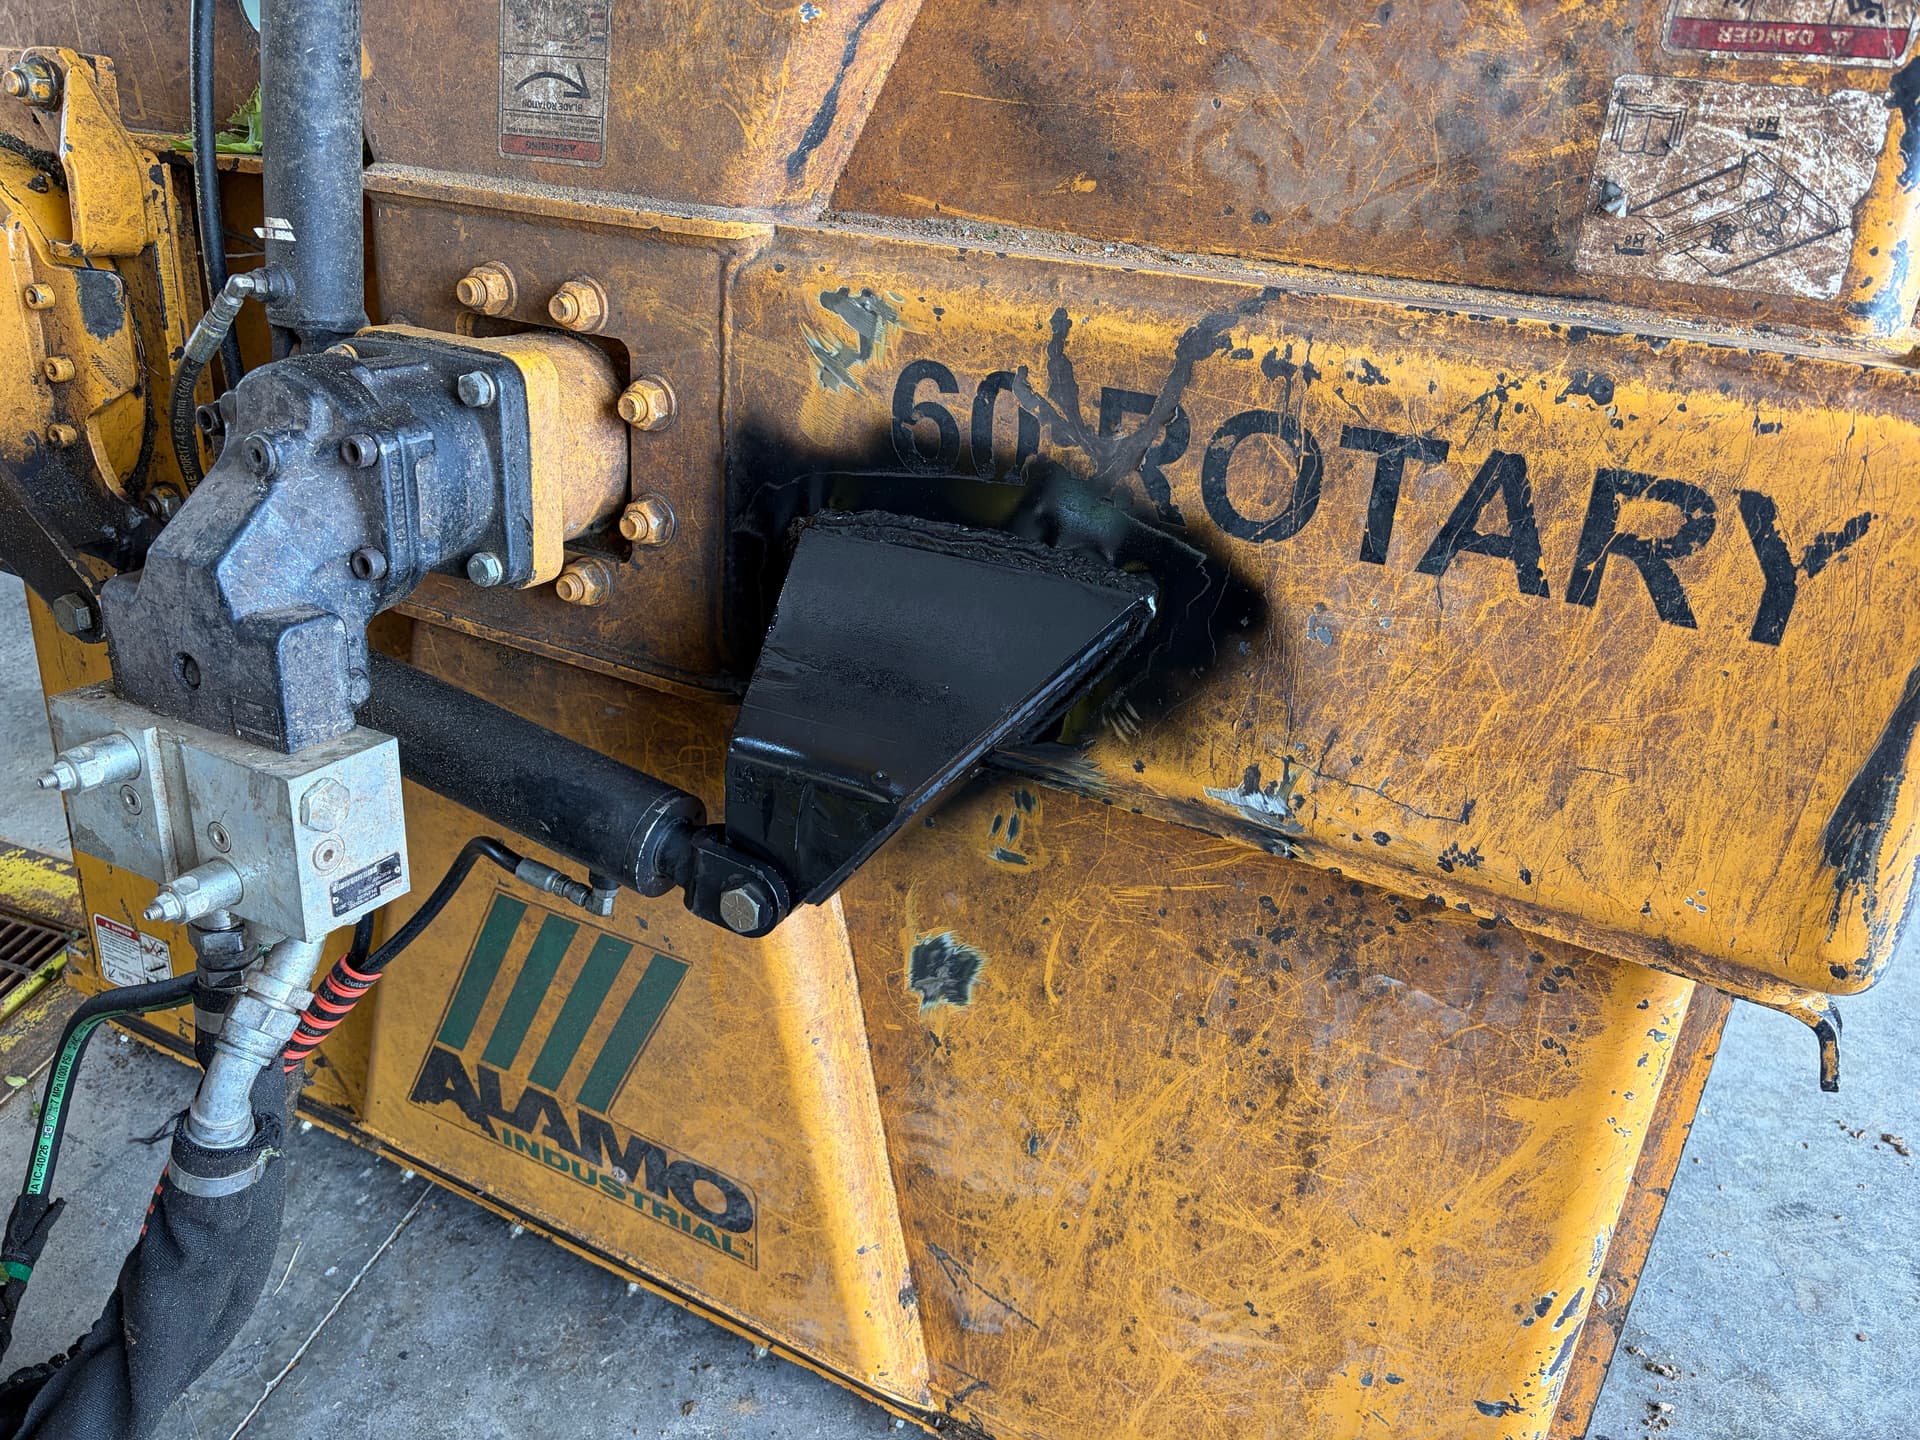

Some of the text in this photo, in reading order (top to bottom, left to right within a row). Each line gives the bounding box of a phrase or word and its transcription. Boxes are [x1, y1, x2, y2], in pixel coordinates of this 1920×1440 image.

[1716, 26, 1815, 46] DANGER
[558, 103, 583, 113] BLADE
[892, 358, 1873, 647] 60 ROTARY
[33, 1144, 49, 1183] IC-40/26
[51, 1082, 64, 1099] MPa
[411, 1046, 754, 1233] ALAMO
[503, 1127, 746, 1261] INDUSTRIAL
